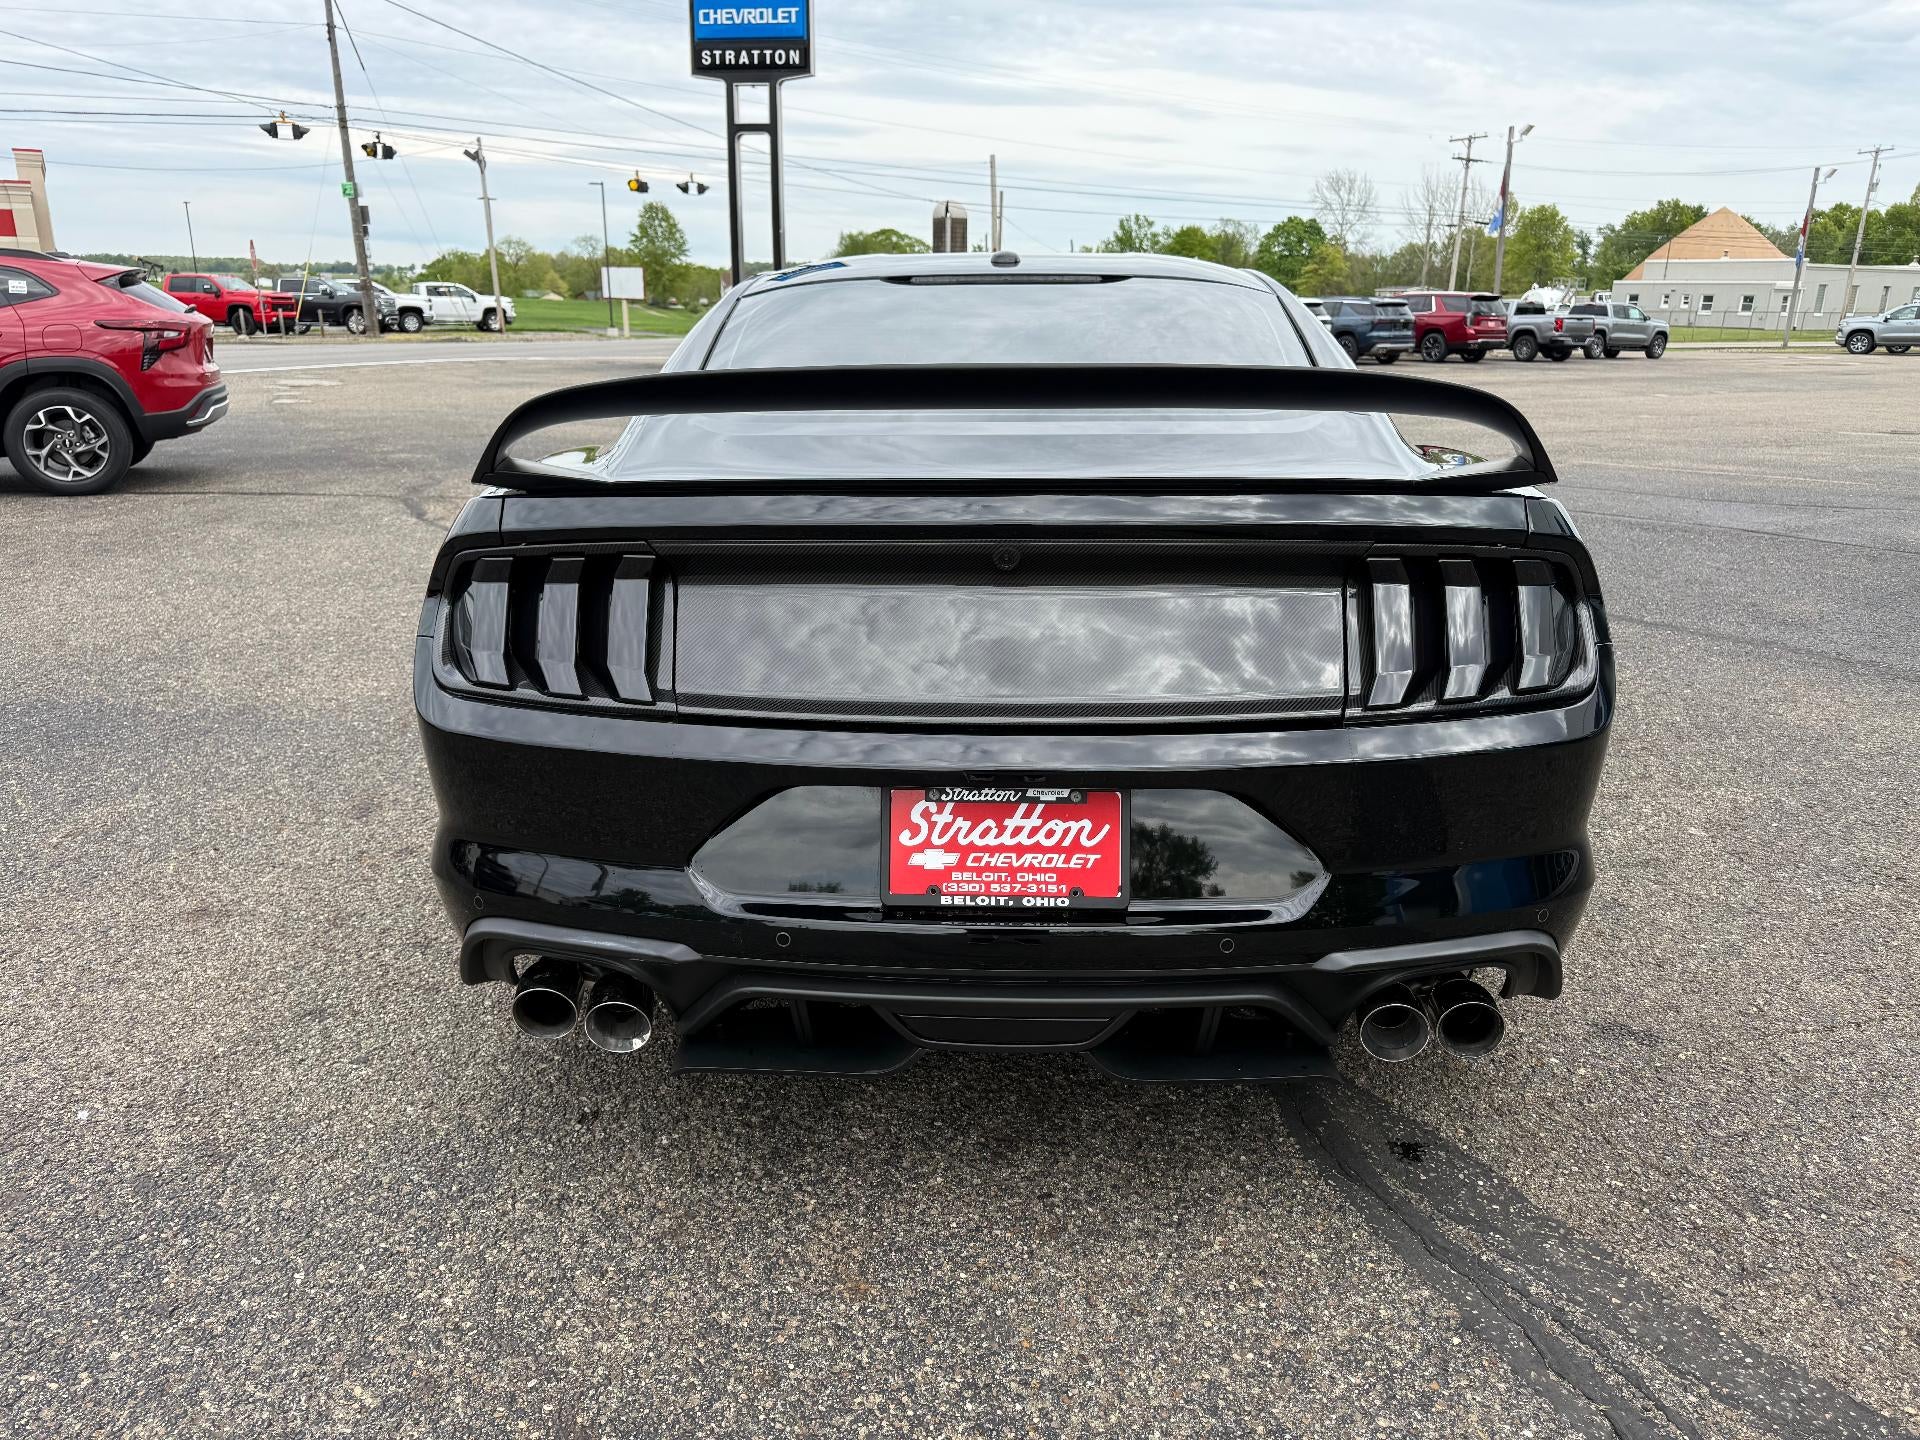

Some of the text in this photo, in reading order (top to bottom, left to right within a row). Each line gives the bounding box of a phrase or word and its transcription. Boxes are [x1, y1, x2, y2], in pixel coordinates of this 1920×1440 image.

[699, 7, 799, 24] CHEVROLET
[701, 49, 799, 65] STRATTON
[940, 787, 1021, 801] Stratton
[899, 799, 1110, 847] Stratton
[966, 852, 1102, 868] CHEVROLET
[951, 872, 1057, 882] BELOIT, OHIO
[942, 883, 1067, 893] (330) 537-3151
[940, 896, 1070, 907] BELOIT, OHIO
